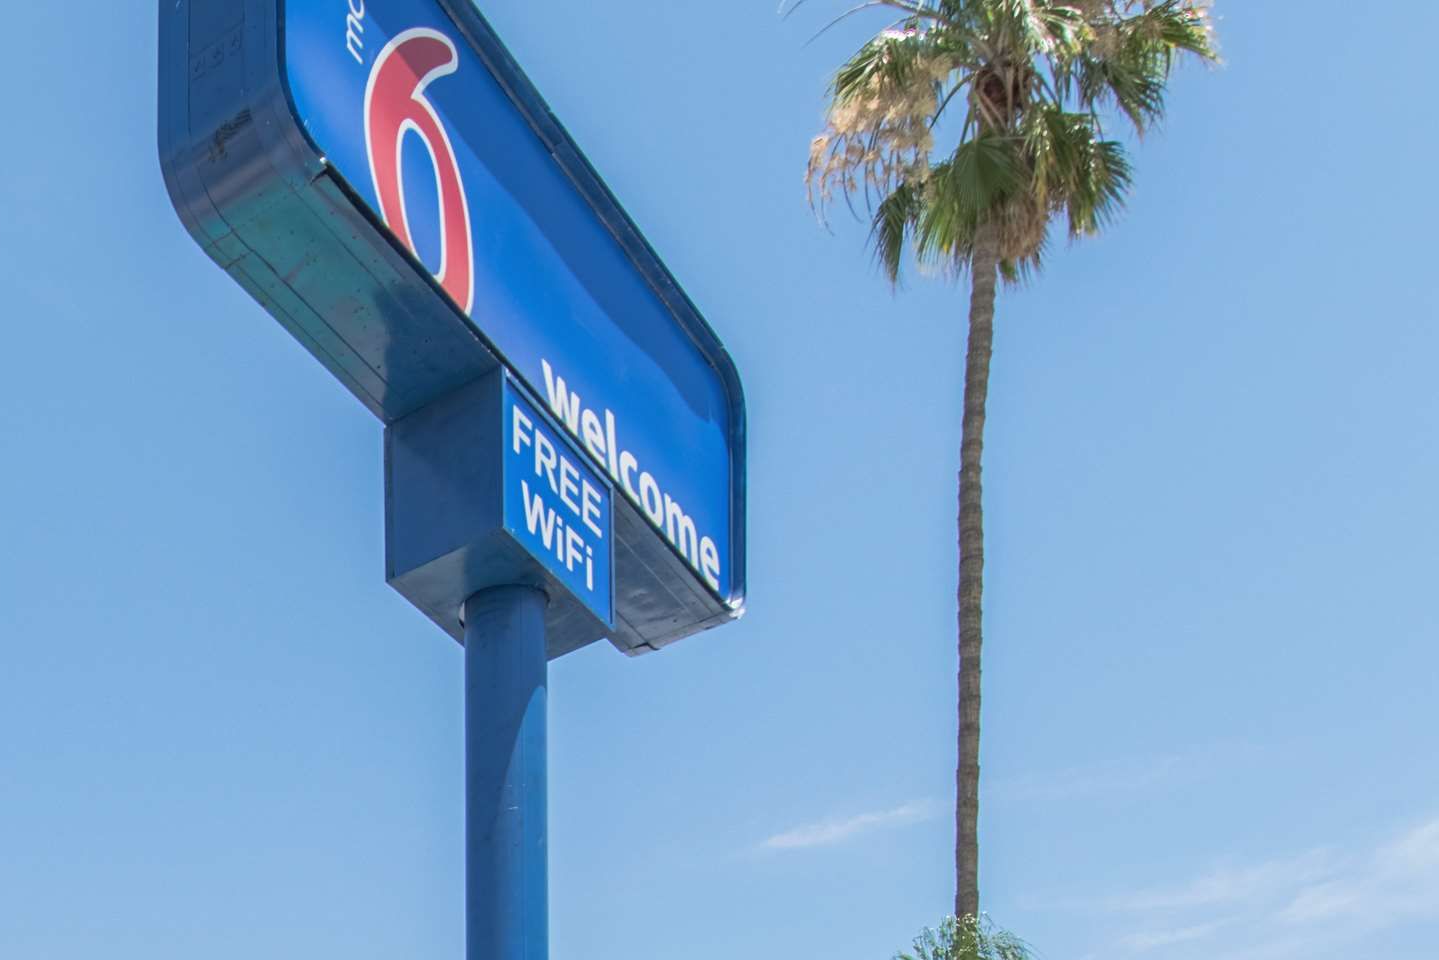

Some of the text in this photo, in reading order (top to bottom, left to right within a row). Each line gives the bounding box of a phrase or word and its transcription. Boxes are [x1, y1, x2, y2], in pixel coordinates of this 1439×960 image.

[364, 27, 474, 316] 6
[513, 405, 602, 538] FREE
[521, 479, 593, 592] WiFi
[541, 358, 720, 591] Welcome
